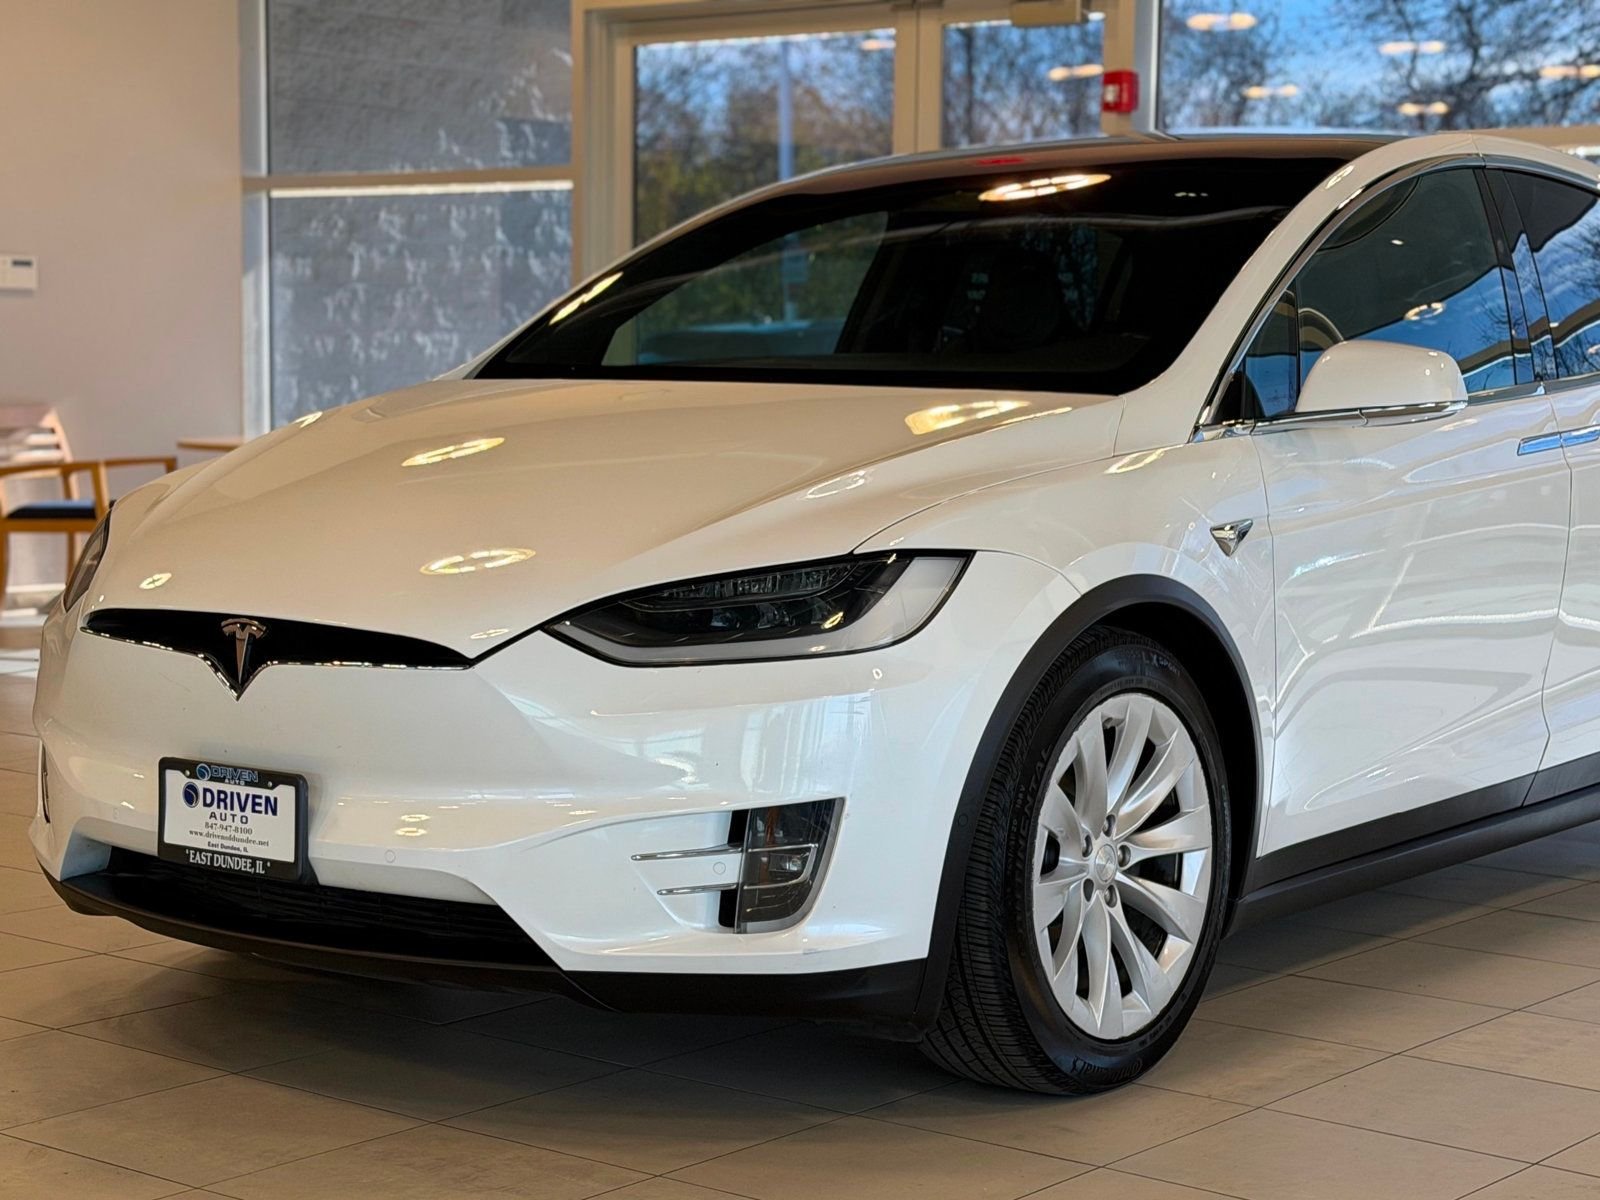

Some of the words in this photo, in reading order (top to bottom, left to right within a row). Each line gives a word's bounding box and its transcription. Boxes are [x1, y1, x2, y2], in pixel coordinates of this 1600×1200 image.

[211, 765, 259, 783] DRIVEN
[224, 778, 246, 786] AUTO
[202, 787, 278, 817] DRIVEN
[209, 811, 249, 825] AUTO
[204, 821, 253, 835] 847-947-8100
[188, 829, 270, 847] www.drivenofdundee.net
[207, 841, 220, 849] East
[220, 842, 243, 853] Dundee,
[213, 852, 255, 874] DUNDEE,
